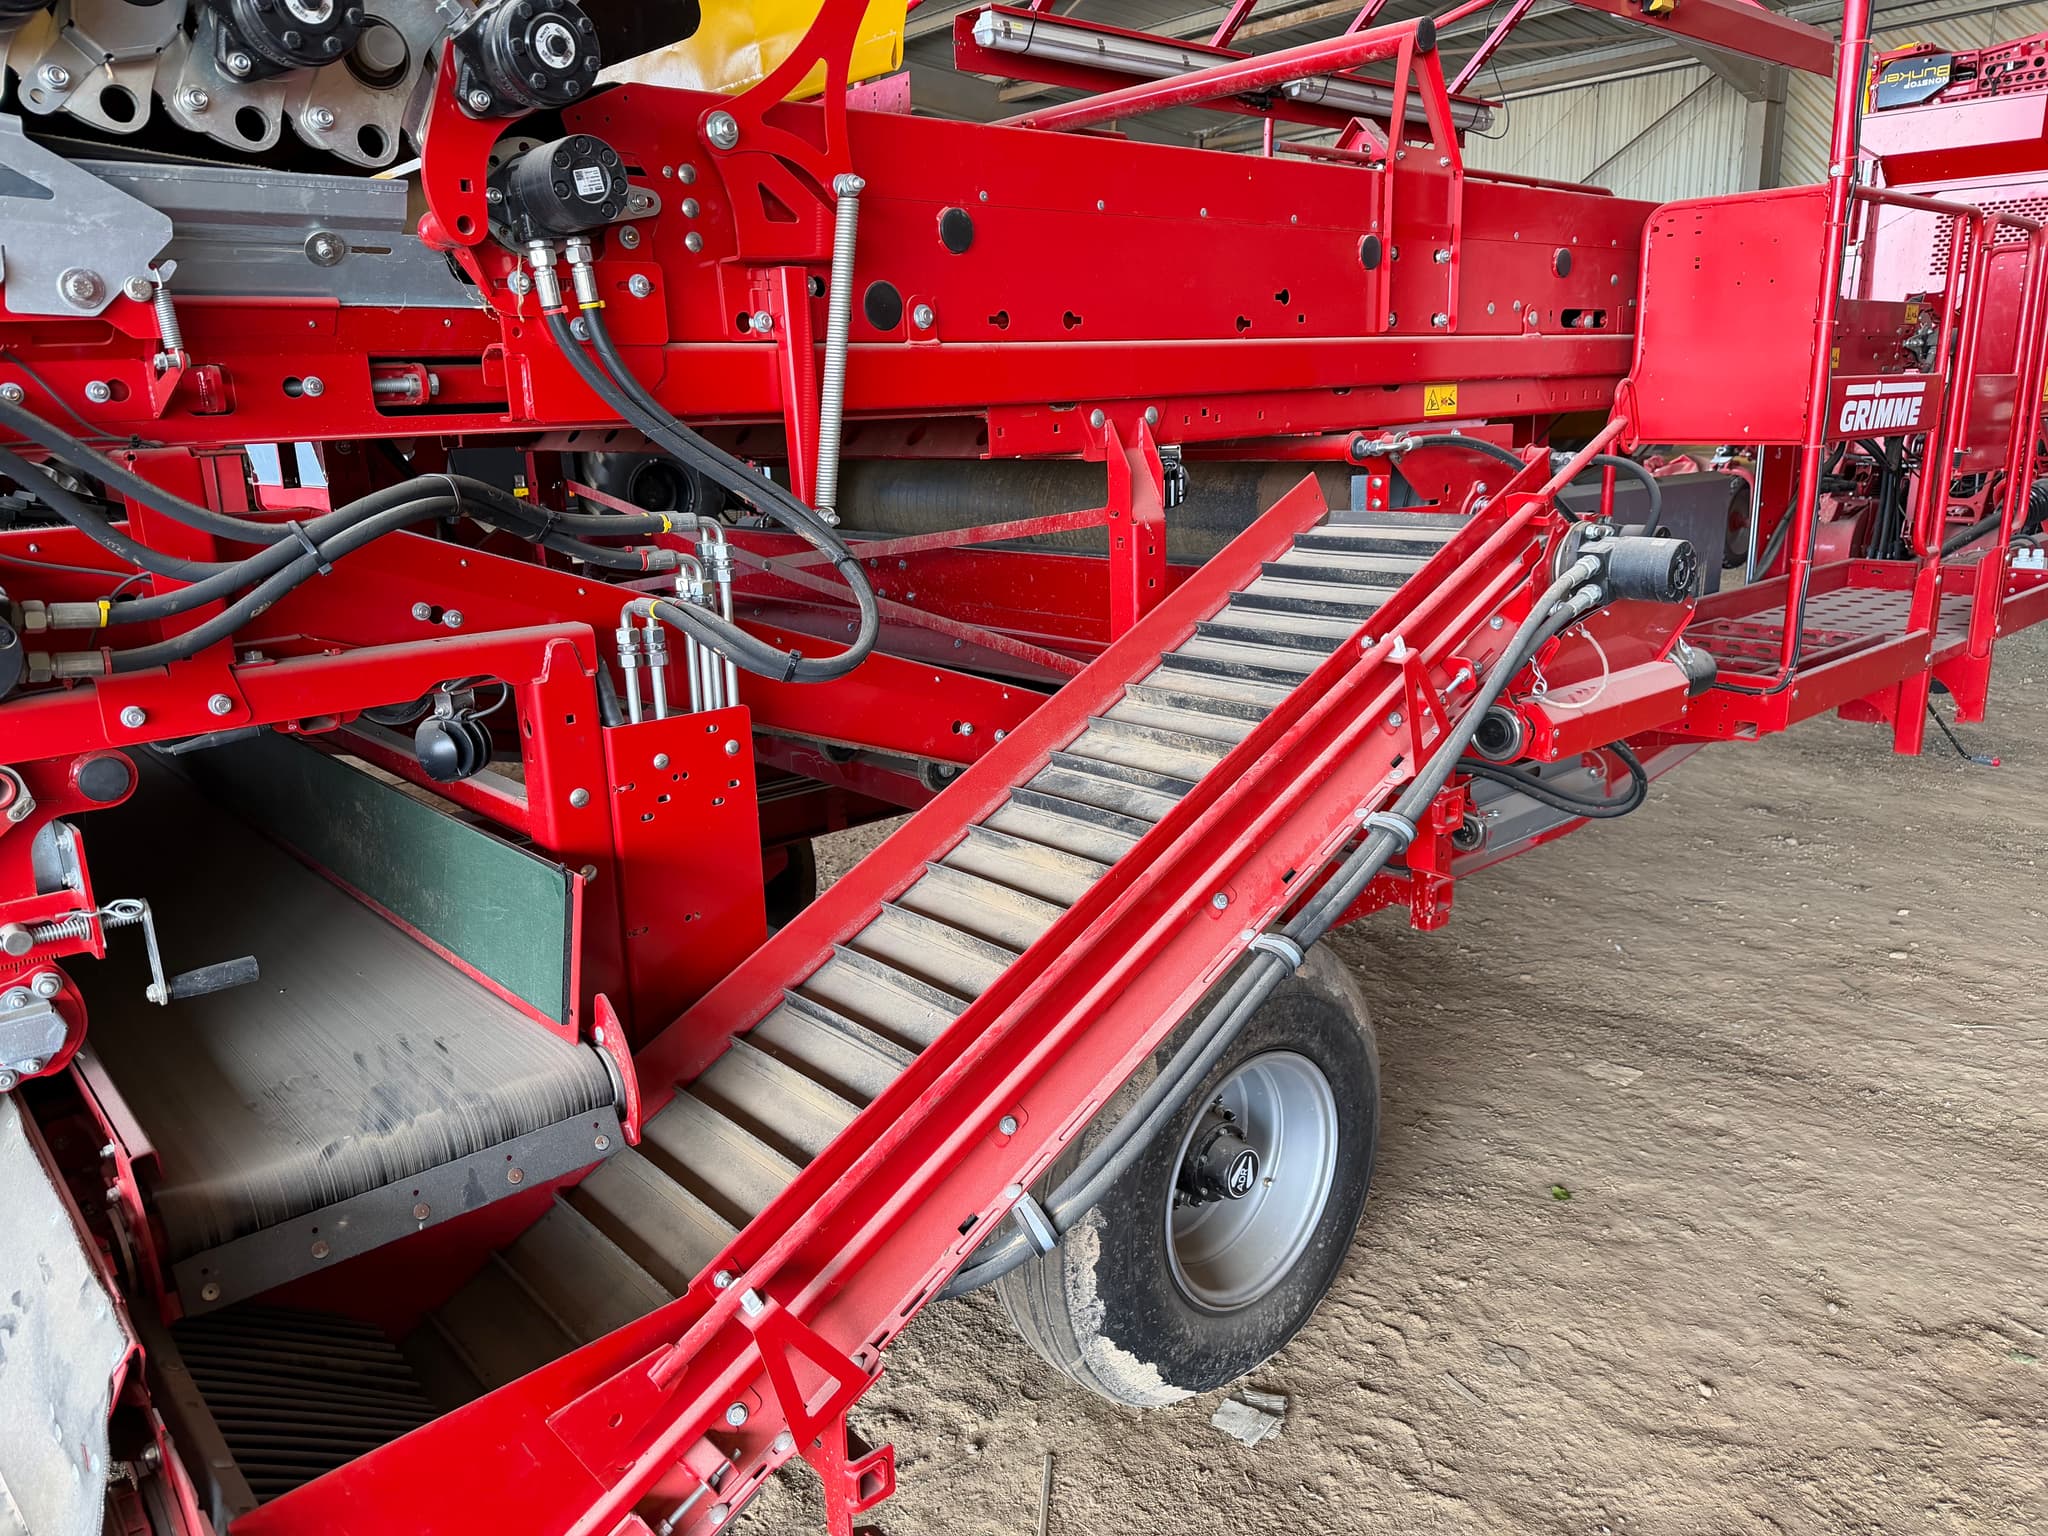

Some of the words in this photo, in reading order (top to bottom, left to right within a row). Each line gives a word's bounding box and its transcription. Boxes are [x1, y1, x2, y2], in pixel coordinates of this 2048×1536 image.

[1879, 64, 1951, 85] Bunker
[1904, 76, 1950, 89] NONSTOP
[1839, 396, 1923, 432] GRIMME
[1237, 1168, 1248, 1192] ADR
